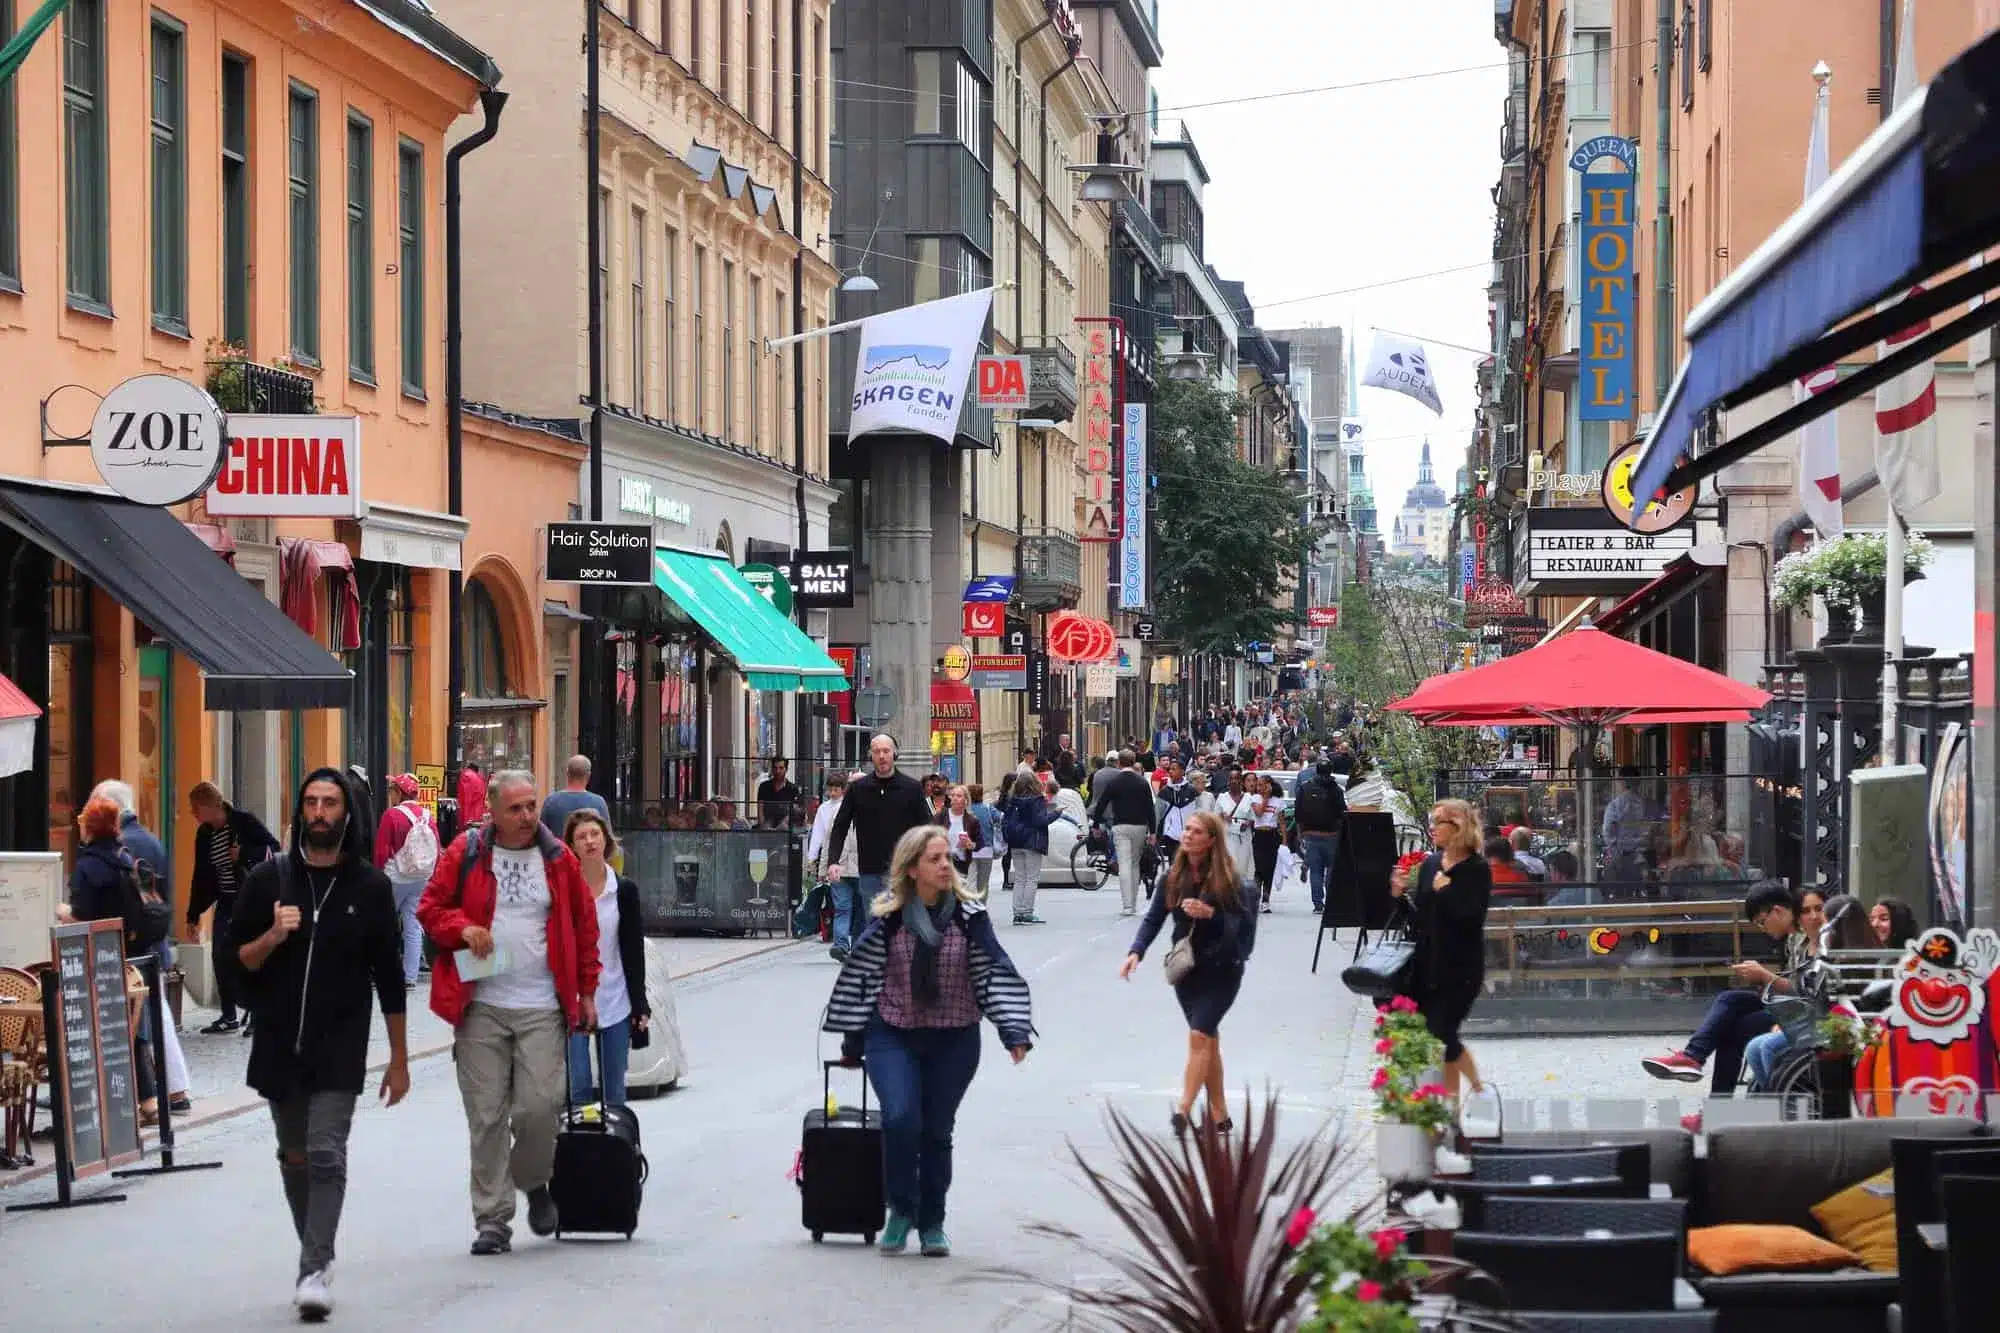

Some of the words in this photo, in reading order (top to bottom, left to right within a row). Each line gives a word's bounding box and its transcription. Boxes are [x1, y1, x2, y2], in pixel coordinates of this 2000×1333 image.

[1585, 188, 1628, 406] HOTEL
[979, 360, 1026, 395] DA
[852, 385, 954, 411] SKAGEN
[107, 411, 204, 451] ZOE
[1088, 329, 1109, 529] SKANDIA
[216, 437, 349, 495] CHINA
[1533, 470, 1602, 496] Play
[551, 529, 584, 546] Hair
[589, 529, 648, 547] Solution
[1538, 537, 1594, 550] TEATER
[1604, 536, 1614, 550] &
[1625, 537, 1655, 550] BAR
[580, 569, 604, 578] DROP
[605, 569, 617, 579] IN
[801, 565, 848, 578] SALT
[1547, 558, 1643, 572] RESTAURANT
[804, 580, 846, 593] MEN
